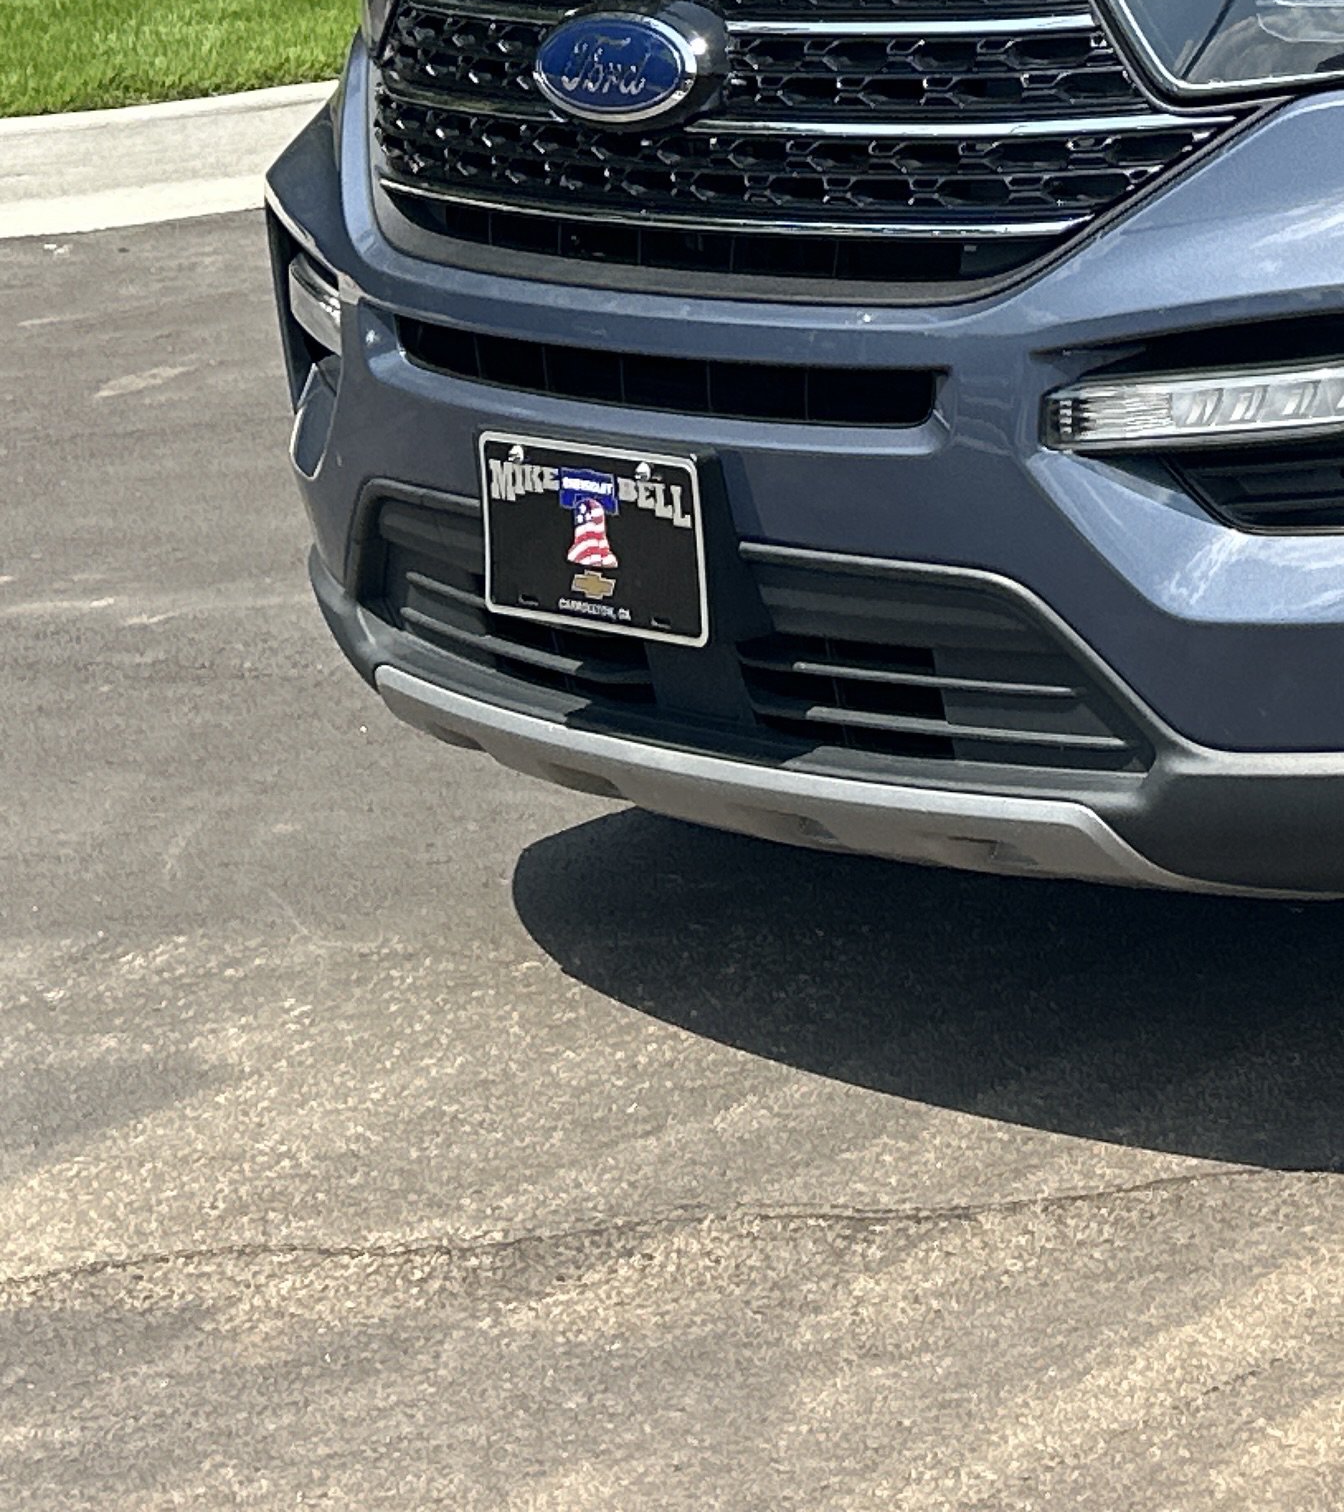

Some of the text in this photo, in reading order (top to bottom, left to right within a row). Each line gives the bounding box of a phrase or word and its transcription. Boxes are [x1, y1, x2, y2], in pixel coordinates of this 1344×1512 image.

[560, 36, 652, 96] Ford
[487, 458, 560, 502] MIKE
[617, 477, 692, 530] BELL
